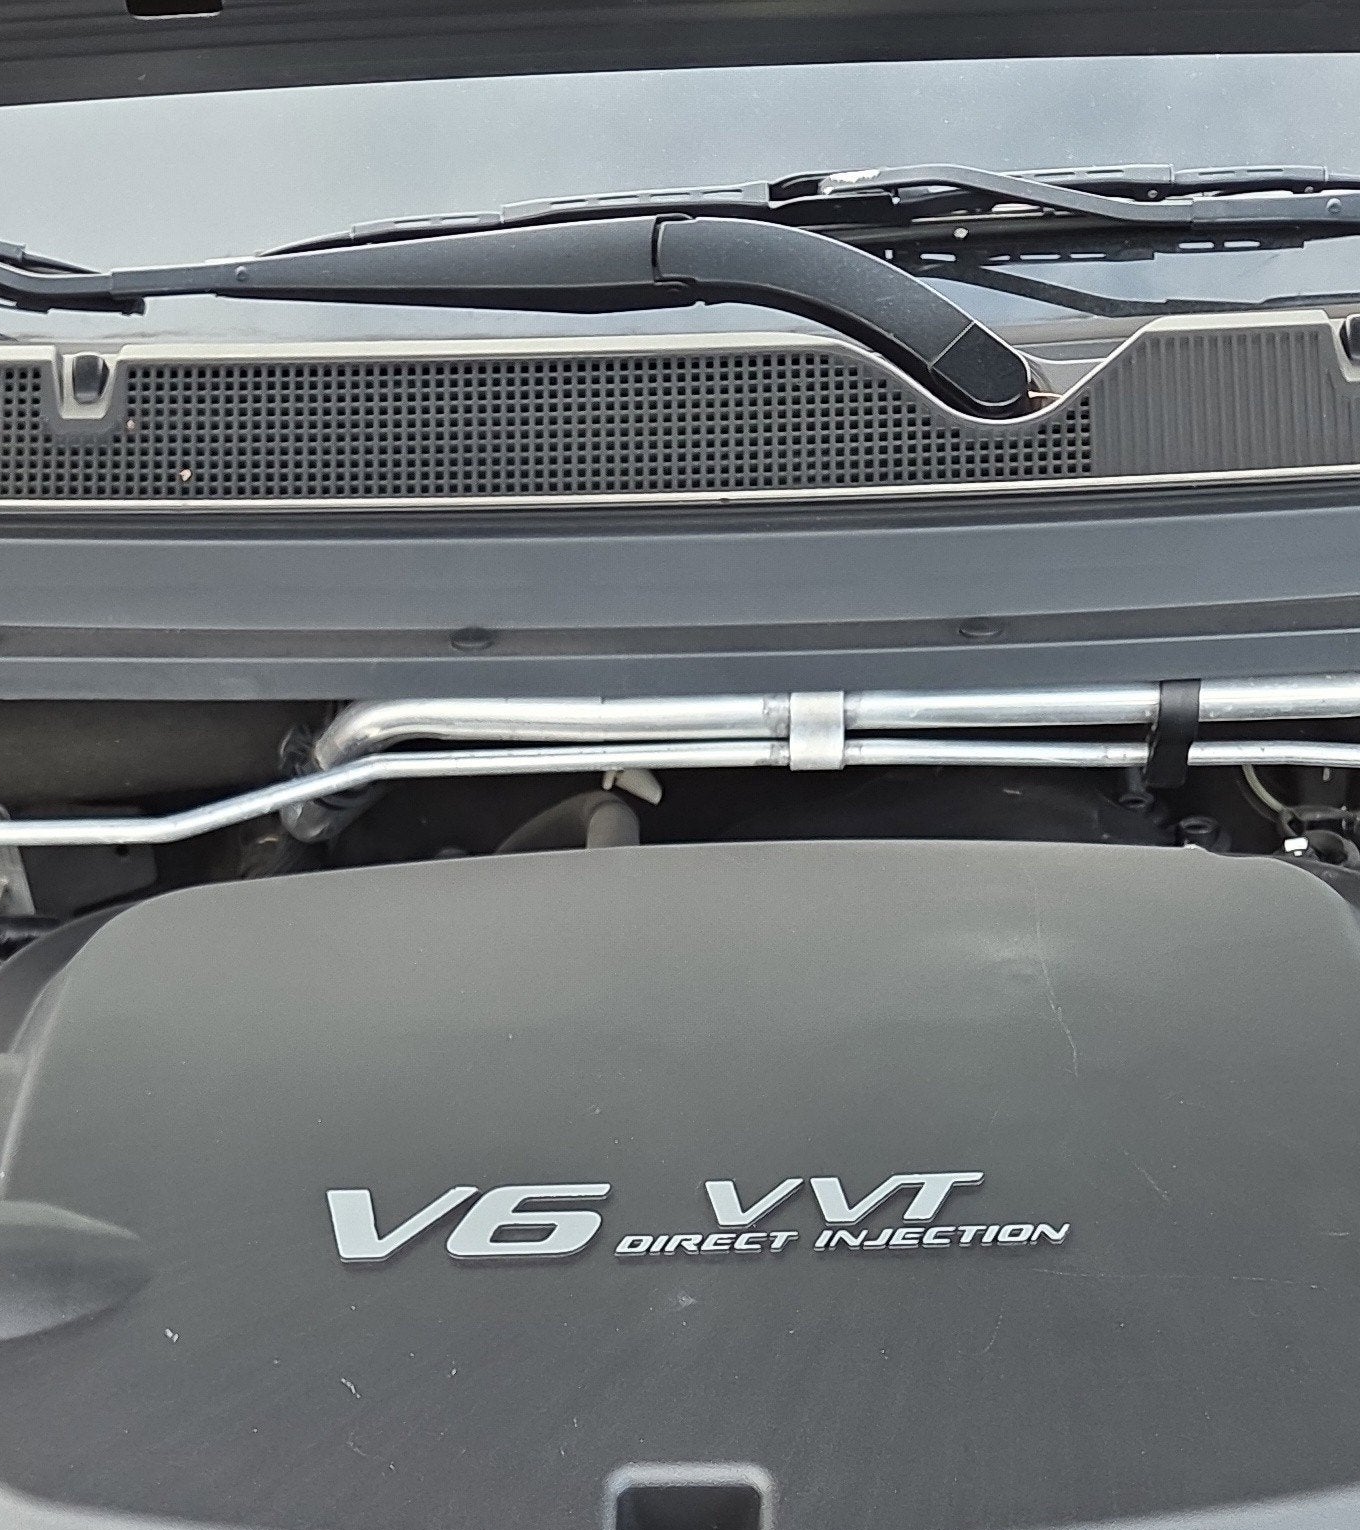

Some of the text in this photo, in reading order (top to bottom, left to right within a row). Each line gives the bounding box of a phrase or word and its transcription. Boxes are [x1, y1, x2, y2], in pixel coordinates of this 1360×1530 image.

[326, 1182, 612, 1261] V6
[705, 1171, 985, 1227] VVT
[614, 1222, 1071, 1257] DIRECT INJECTION
